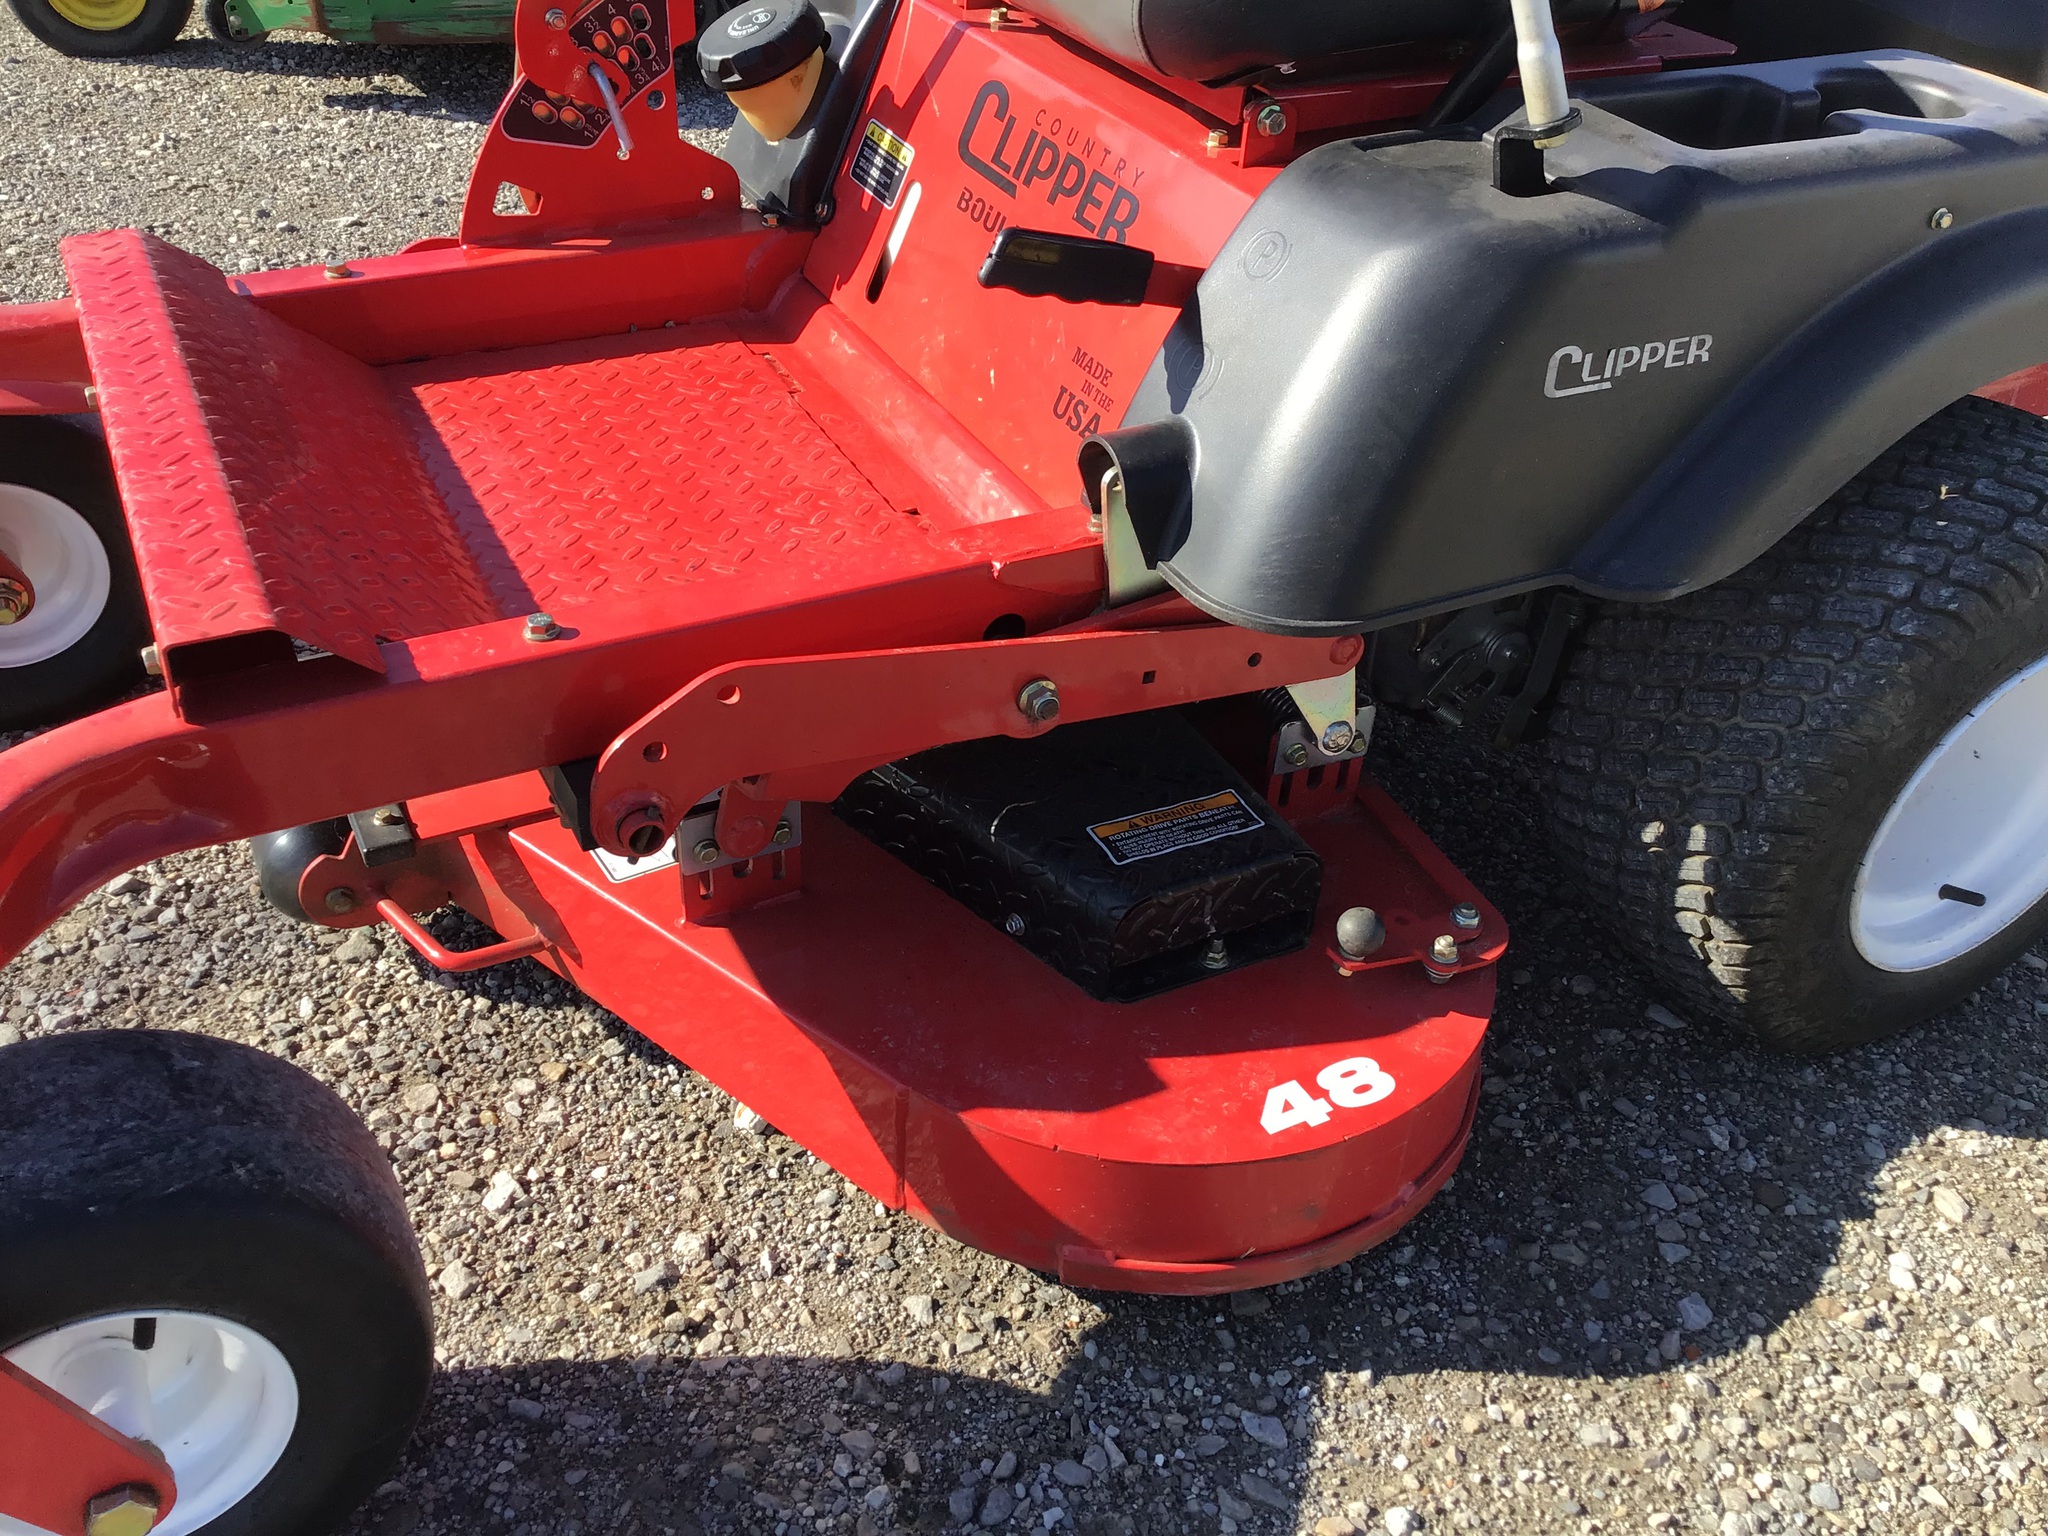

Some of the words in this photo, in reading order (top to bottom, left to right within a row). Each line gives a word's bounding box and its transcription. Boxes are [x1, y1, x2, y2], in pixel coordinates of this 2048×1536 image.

[958, 80, 1140, 244] CLIPPER
[1036, 109, 1145, 188] COUNTRY
[1071, 346, 1114, 388] MADE
[1081, 379, 1095, 397] IN
[1093, 388, 1114, 413] THE
[1543, 334, 1713, 399] CLIPPER
[1053, 385, 1101, 439] USA
[1140, 802, 1207, 825] WARNING
[1260, 1057, 1396, 1135] 48
